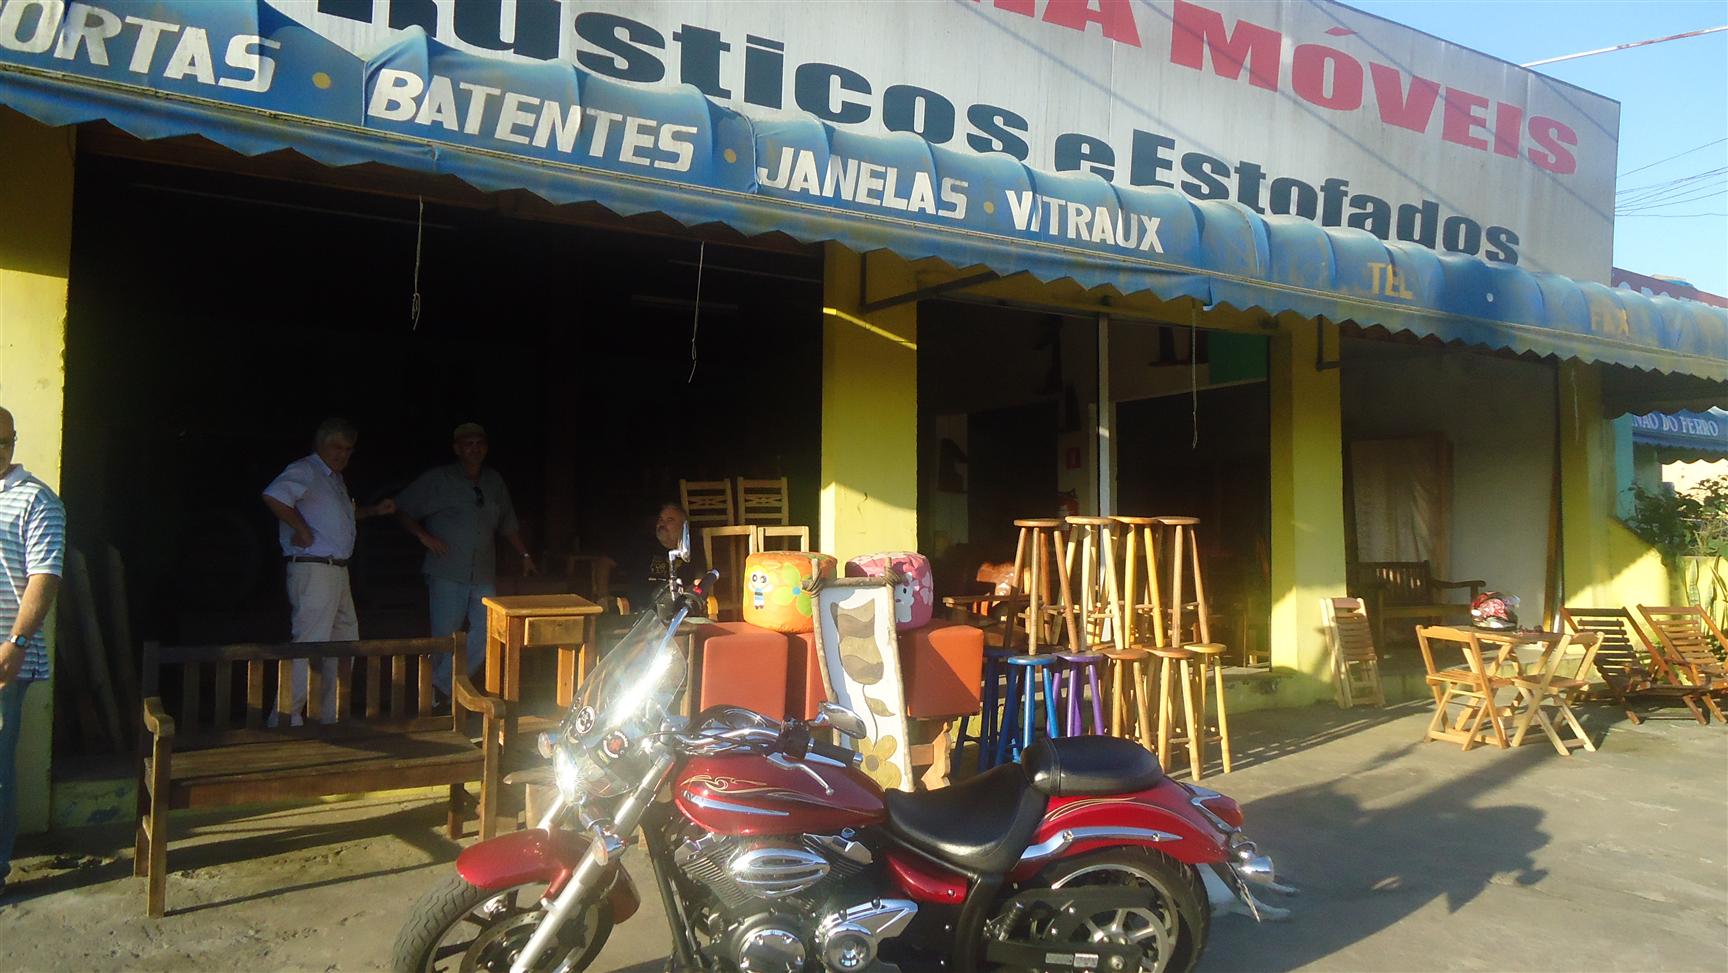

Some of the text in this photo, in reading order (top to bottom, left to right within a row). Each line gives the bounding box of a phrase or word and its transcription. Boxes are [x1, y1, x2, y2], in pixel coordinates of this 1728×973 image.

[368, 68, 698, 172] BATENTES
[756, 147, 968, 220] JANELAS
[1006, 190, 1164, 254] VITRAUX
[1170, 0, 1578, 175] MÓVEIS
[1055, 133, 1115, 184] e
[1130, 129, 1520, 265] Estofados
